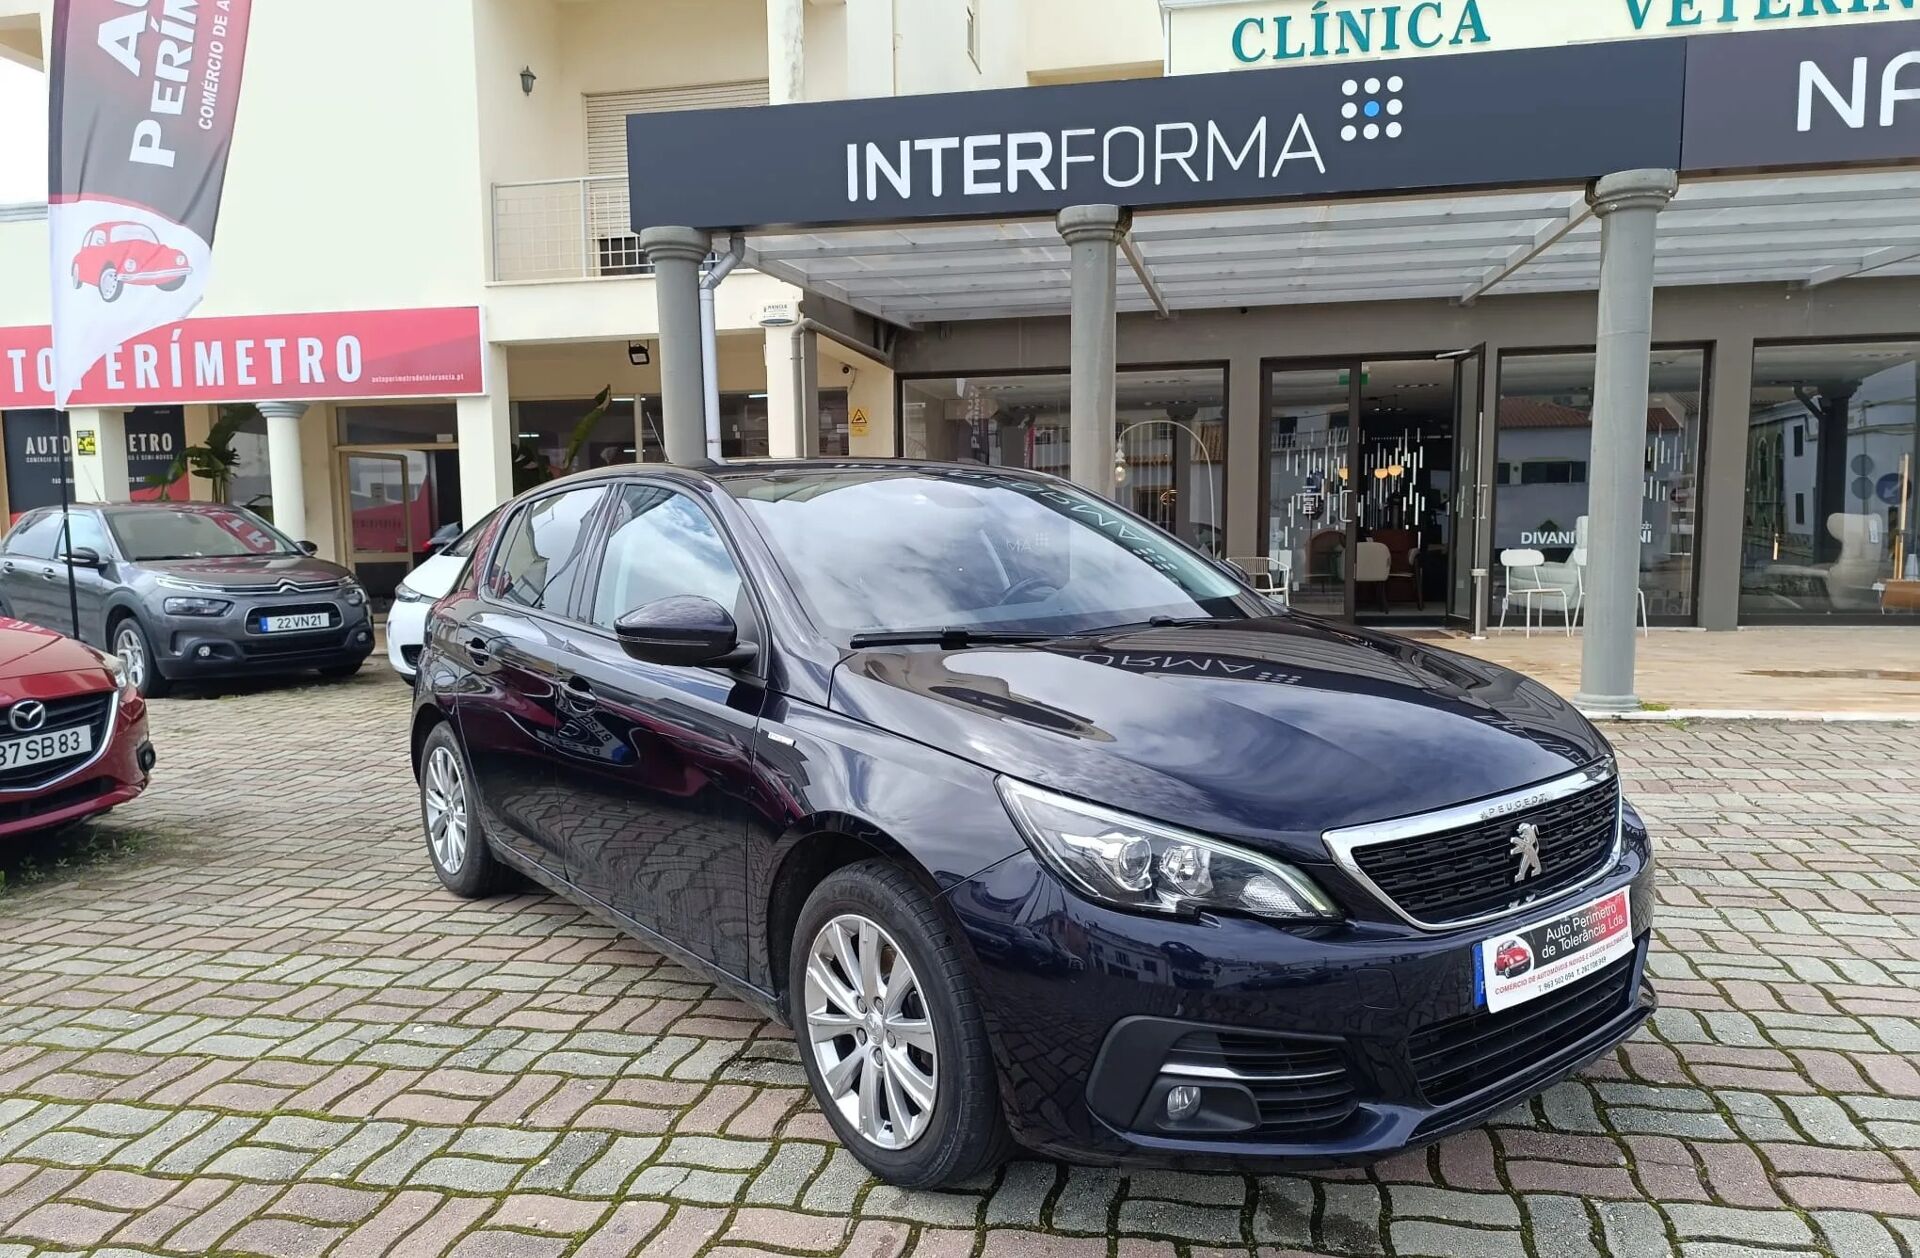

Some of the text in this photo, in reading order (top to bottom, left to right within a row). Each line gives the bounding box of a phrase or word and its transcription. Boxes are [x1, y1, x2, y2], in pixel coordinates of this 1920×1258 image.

[1231, 0, 1491, 63] CLÍNICA
[199, 41, 223, 130] COMÉRCIO
[212, 15, 228, 37] DE
[847, 112, 1326, 202] INTERFORMA
[8, 328, 362, 393] TOERÍMETRO
[26, 435, 71, 455] AUTO
[1521, 530, 1575, 545] DIVANI
[1489, 793, 1547, 815] PEUGEOT
[1541, 945, 1556, 959] de
[1558, 924, 1606, 951] Tolerância
[1546, 924, 1571, 943] Auto
[1554, 974, 1565, 986] 502
